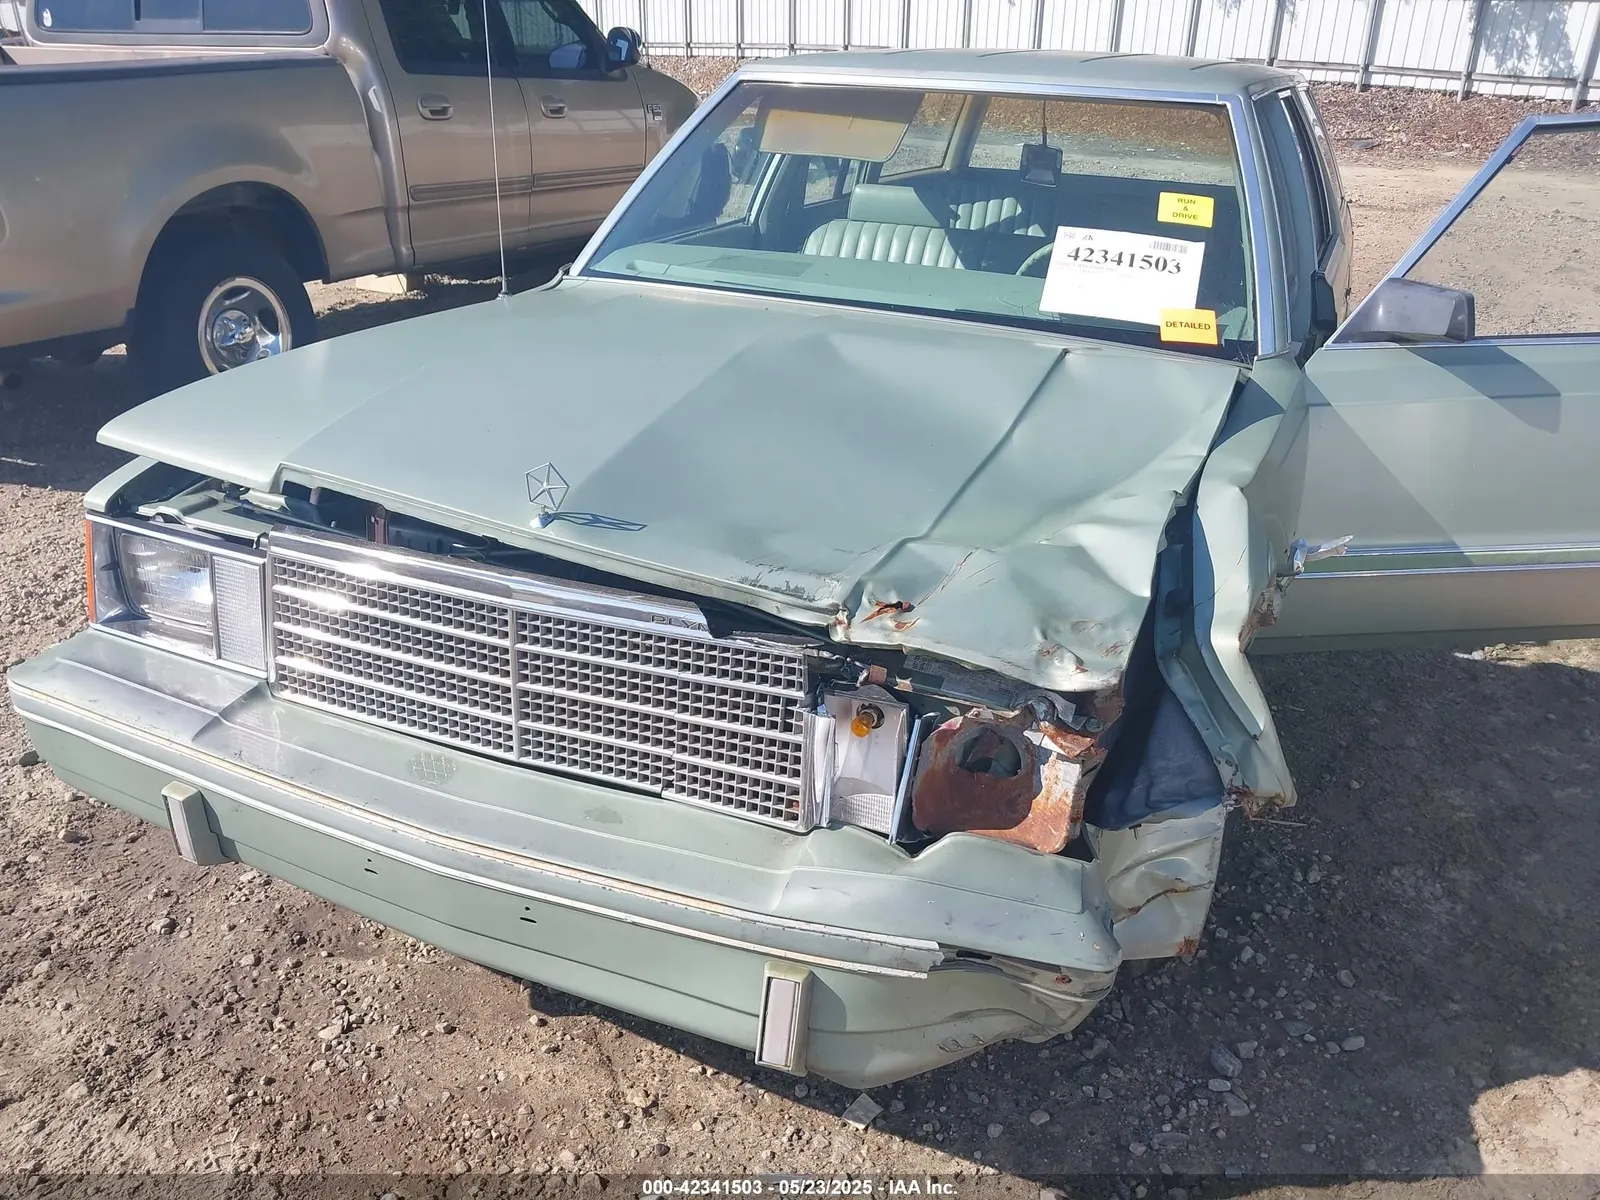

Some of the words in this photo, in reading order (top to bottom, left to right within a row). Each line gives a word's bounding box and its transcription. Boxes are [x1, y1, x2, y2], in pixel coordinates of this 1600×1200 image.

[1177, 197, 1196, 205] RUN
[1172, 211, 1198, 221] DRIVE
[1066, 246, 1182, 275] 42341503
[1165, 320, 1211, 331] DETAILED
